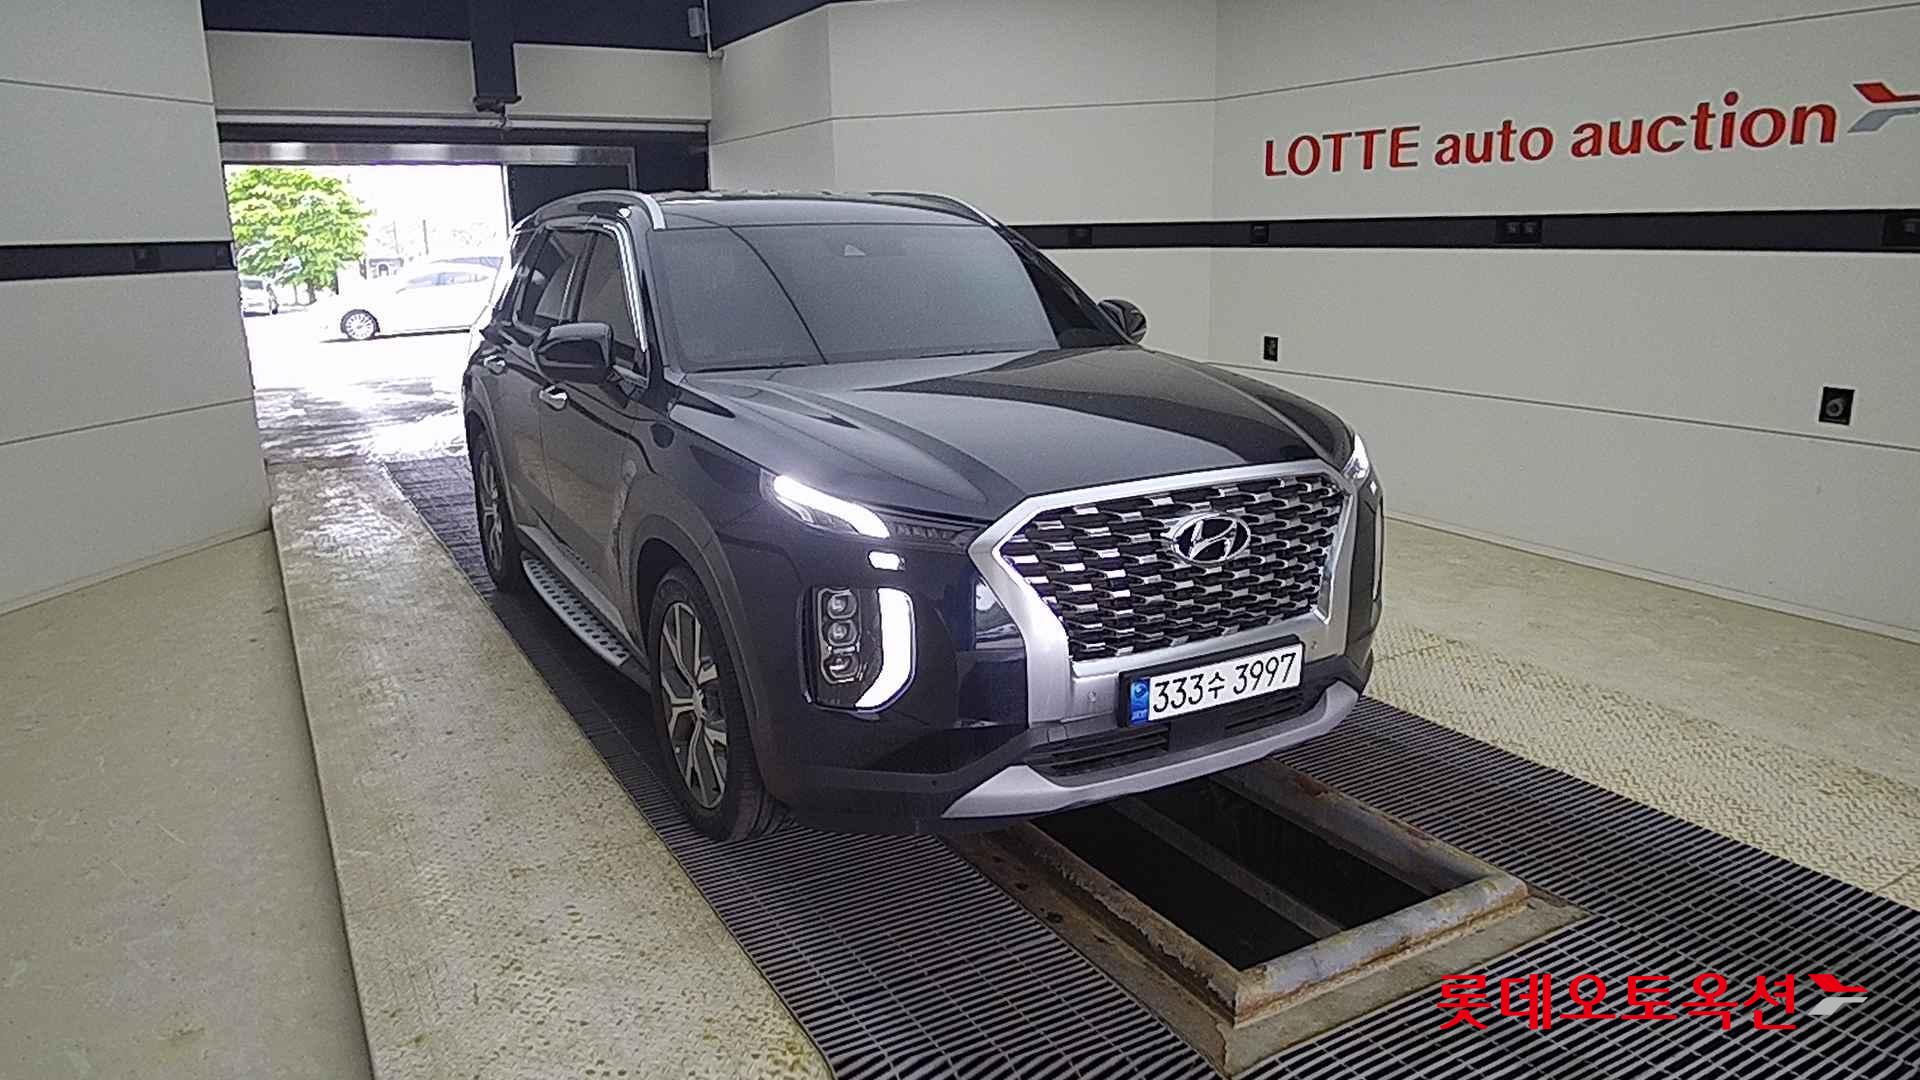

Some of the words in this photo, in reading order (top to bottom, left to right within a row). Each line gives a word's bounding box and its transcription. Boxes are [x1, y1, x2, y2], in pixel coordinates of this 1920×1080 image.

[1265, 126, 1421, 177] LOTTE
[1434, 119, 1554, 168] auto
[1570, 91, 1837, 159] auction
[1153, 672, 1225, 713] 333수
[1233, 652, 1297, 695] 3997
